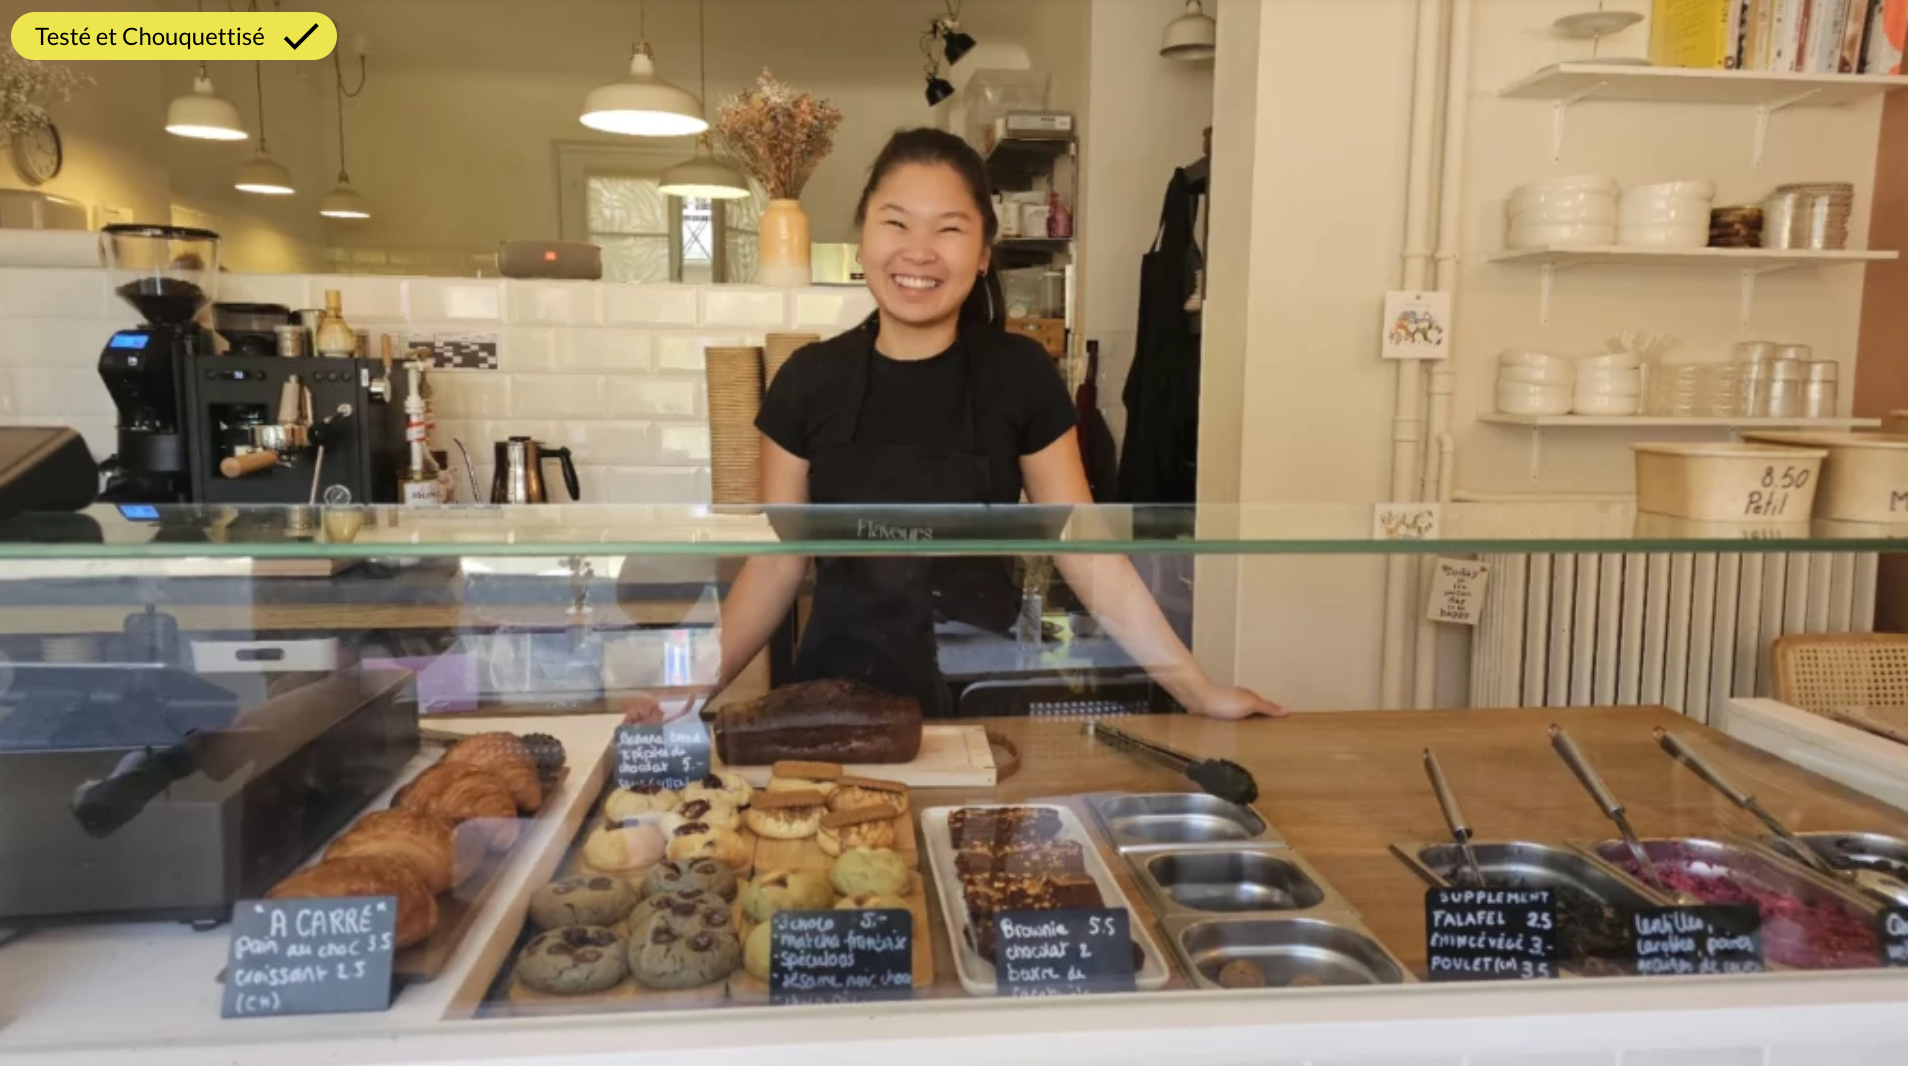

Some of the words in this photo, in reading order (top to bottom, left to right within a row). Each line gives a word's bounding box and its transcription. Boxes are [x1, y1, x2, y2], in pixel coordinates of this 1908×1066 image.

[1761, 466, 1810, 489] 8.50
[1440, 607, 1471, 620] happy
[1438, 890, 1550, 904] SUPPLEMENT
[999, 917, 1069, 939] Brownie
[1088, 916, 1115, 936] 5.5
[1432, 910, 1506, 928] FALAFEL
[286, 943, 313, 958] au
[318, 940, 361, 958] choc
[1005, 941, 1071, 960] chocolat
[234, 965, 328, 986] croissant
